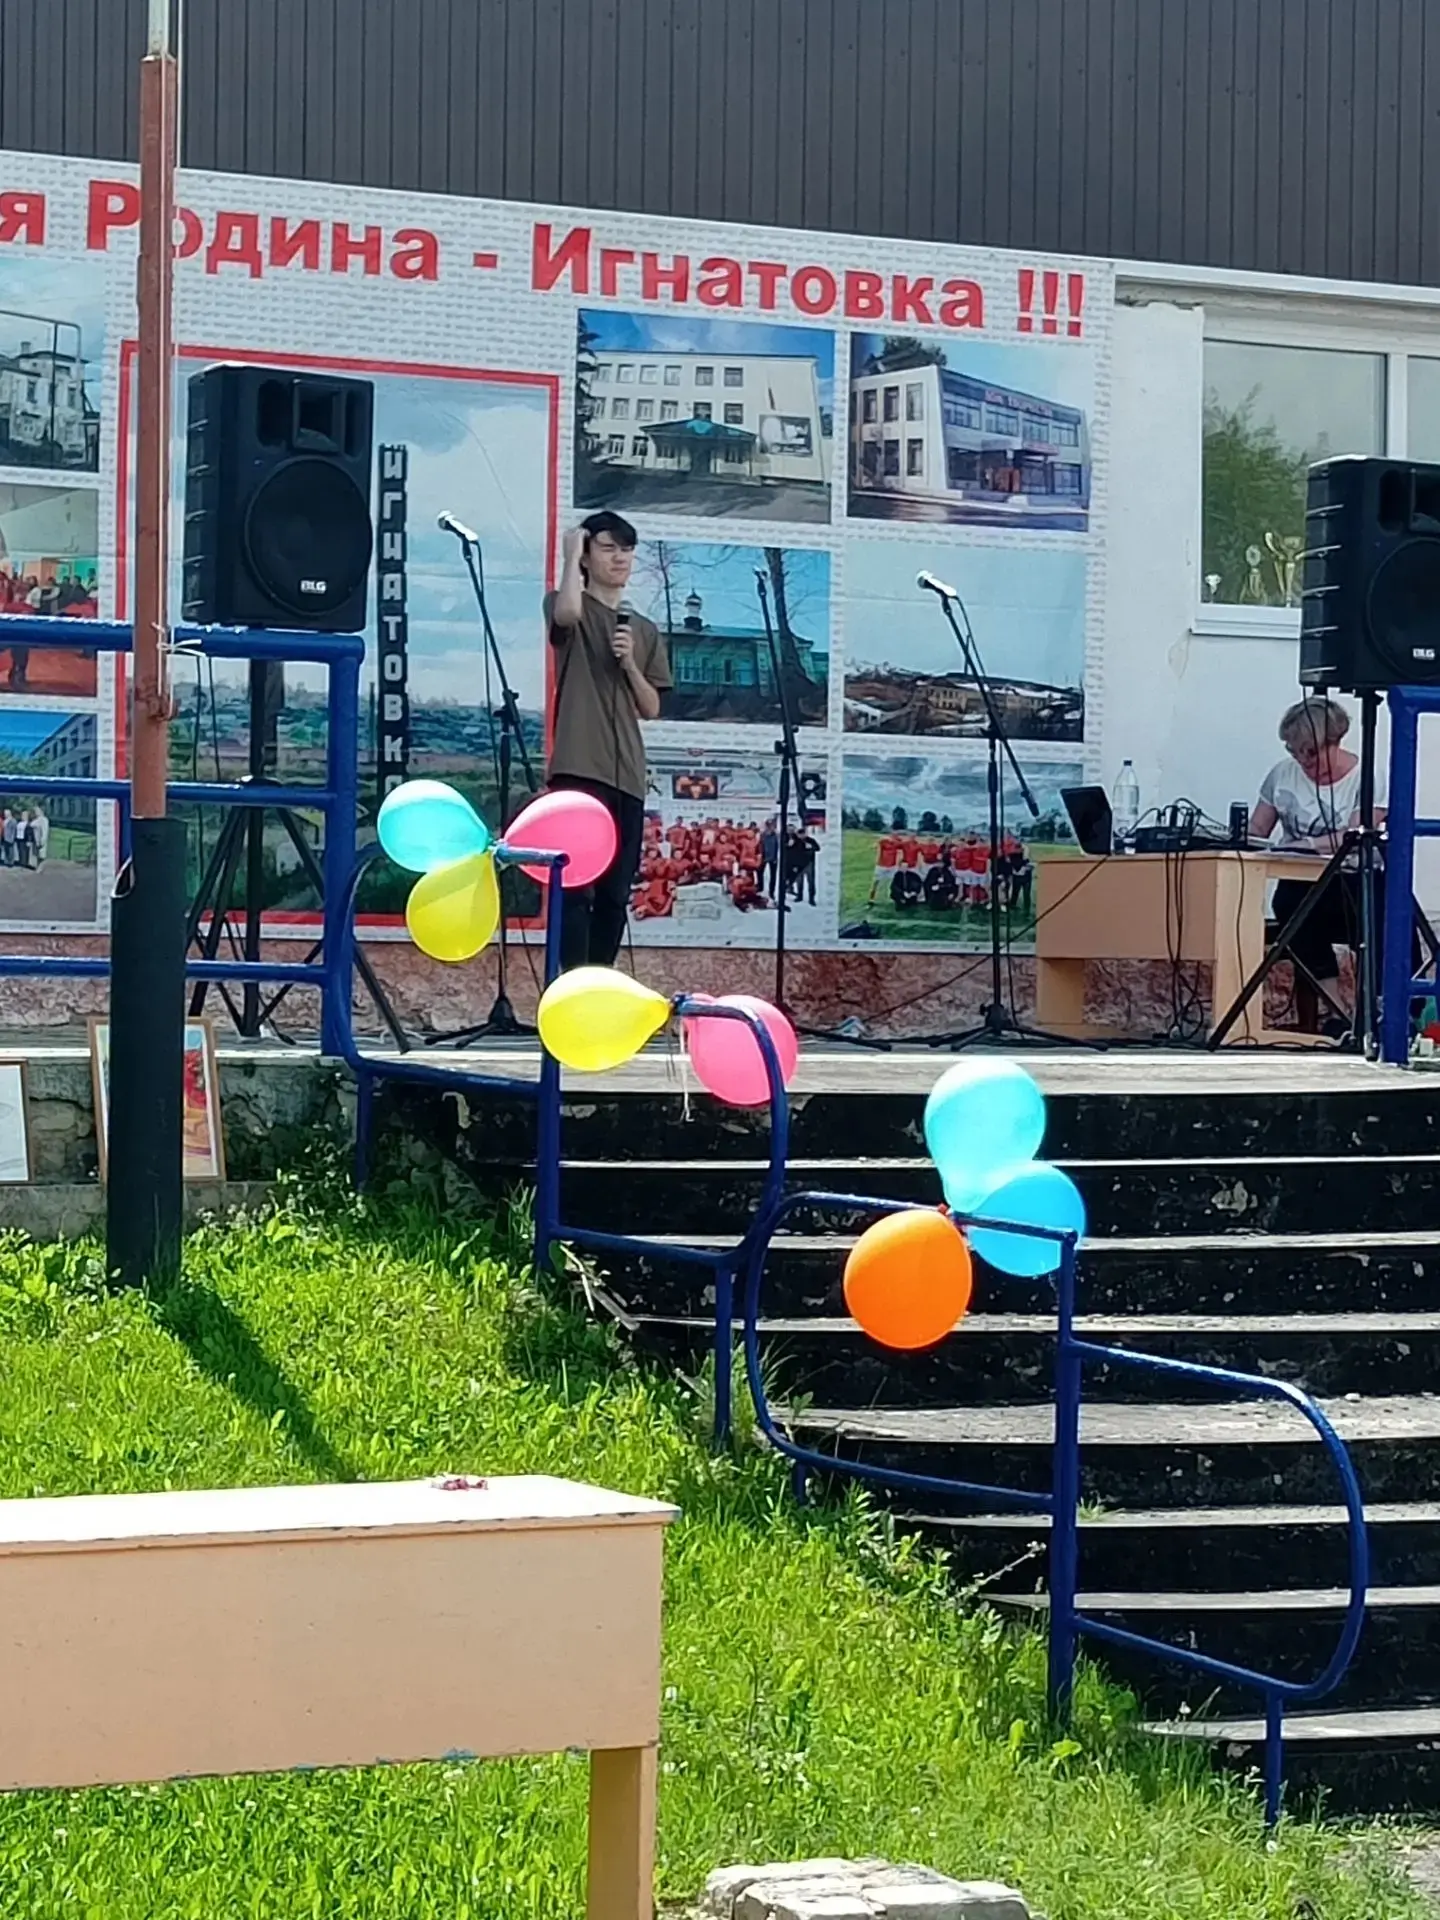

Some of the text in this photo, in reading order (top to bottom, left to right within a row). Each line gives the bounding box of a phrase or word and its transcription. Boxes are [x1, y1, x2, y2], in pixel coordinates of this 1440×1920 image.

[86, 179, 438, 281] Родина
[531, 222, 984, 328] Игнатовка
[1016, 268, 1084, 336] !!!
